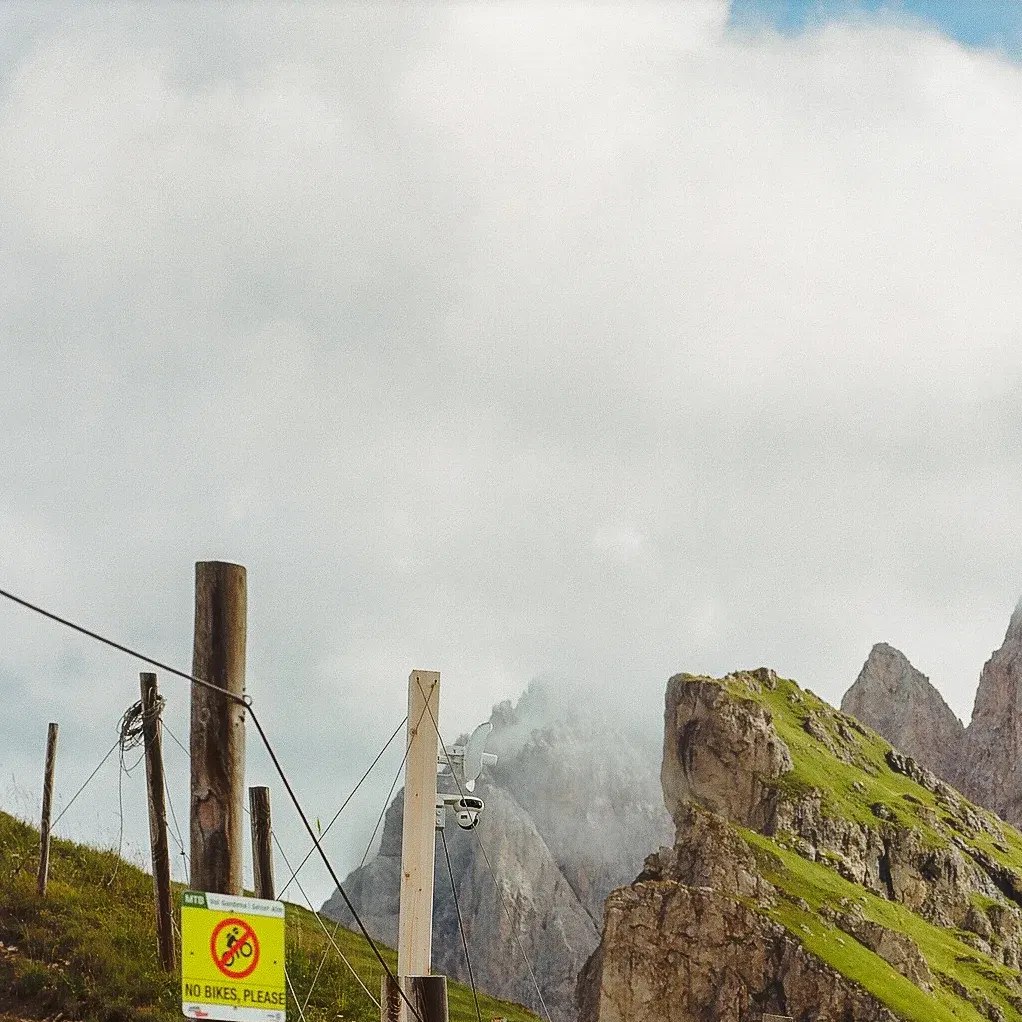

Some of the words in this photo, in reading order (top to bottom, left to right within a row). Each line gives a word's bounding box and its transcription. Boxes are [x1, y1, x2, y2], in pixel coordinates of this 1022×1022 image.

[185, 894, 204, 904] MTB
[185, 983, 200, 997] NO
[205, 985, 240, 1002] BIKES,
[244, 990, 285, 1005] PLEASE
